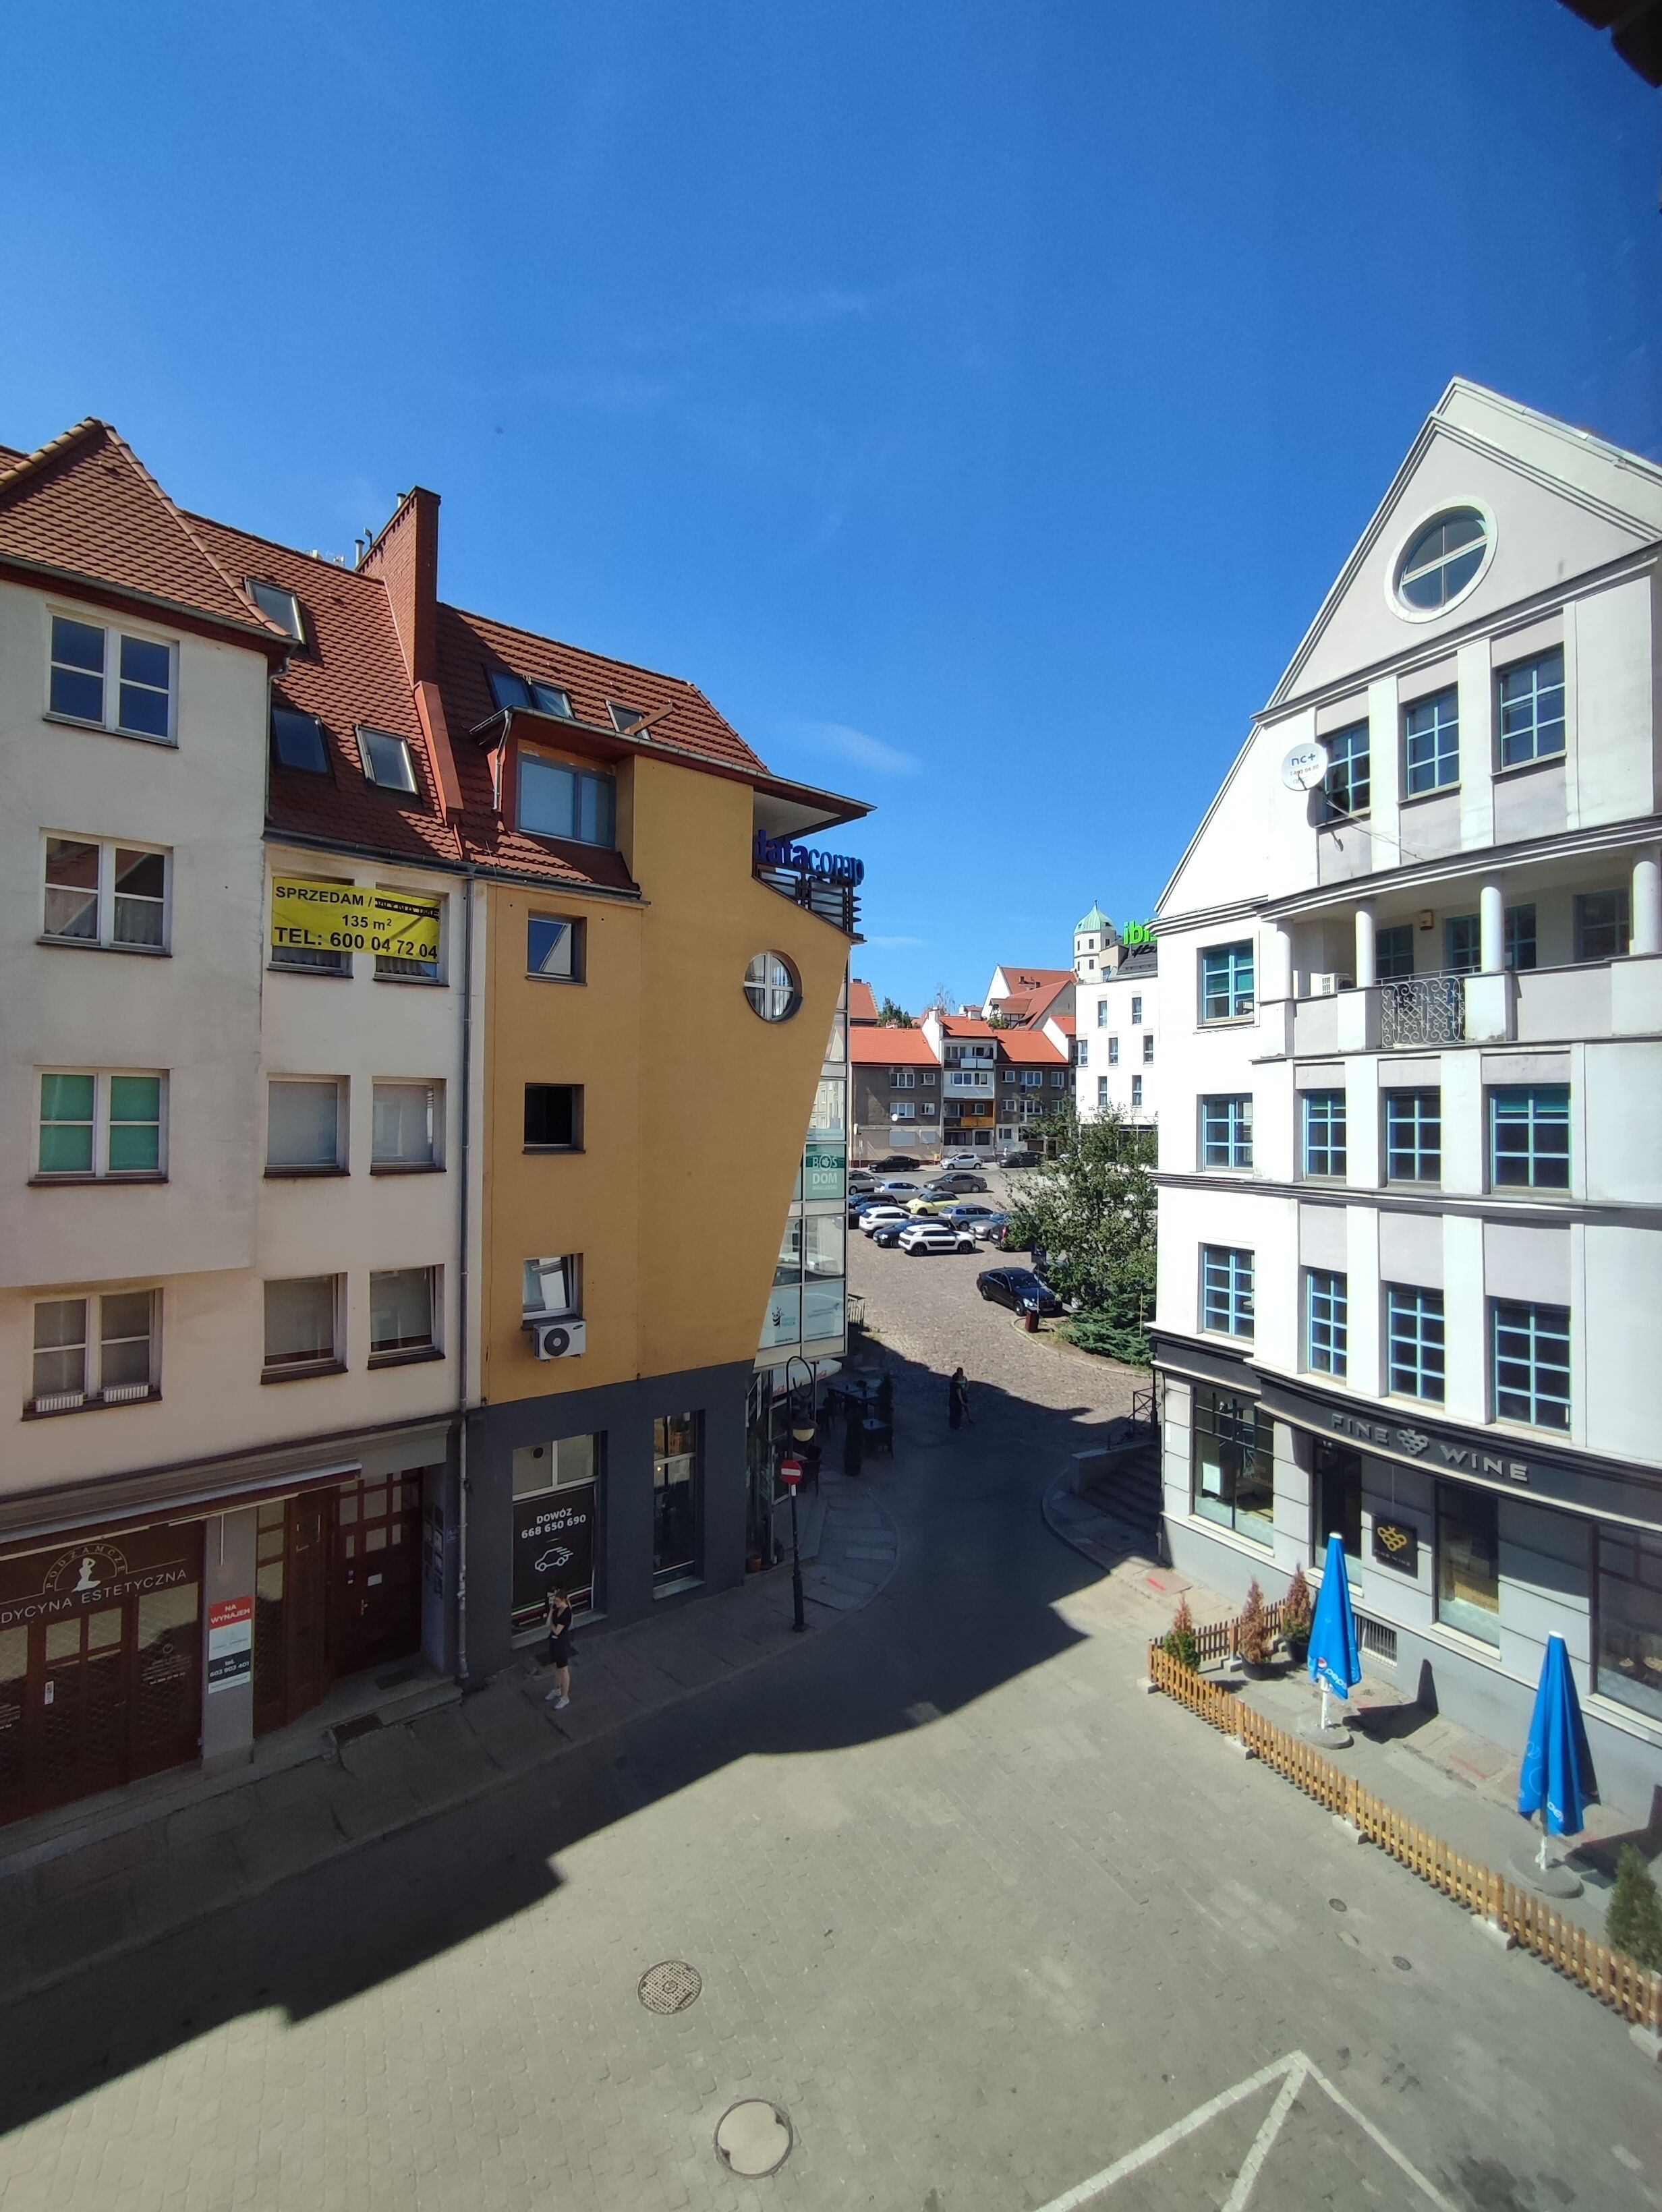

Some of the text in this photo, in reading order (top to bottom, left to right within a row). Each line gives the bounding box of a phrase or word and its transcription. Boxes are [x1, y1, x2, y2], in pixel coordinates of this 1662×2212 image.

[1291, 753, 1316, 766] nc+
[753, 829, 865, 887] datacomp
[275, 885, 364, 907] SPRZEDAM
[341, 914, 369, 928] 135
[1123, 918, 1158, 945] ibi
[274, 927, 438, 960] TEL: 600 04 72 04
[812, 1173, 838, 1184] DOM
[1331, 1413, 1528, 1482] FINE WINE
[521, 1514, 587, 1539] 668 650 690
[536, 1507, 573, 1524] DOWÓZ
[46, 1545, 125, 1589] PODZAMCZE
[81, 1569, 187, 1604] ESTETYCZNA
[210, 1608, 251, 1624] WYNAJEM
[225, 1604, 237, 1612] NA
